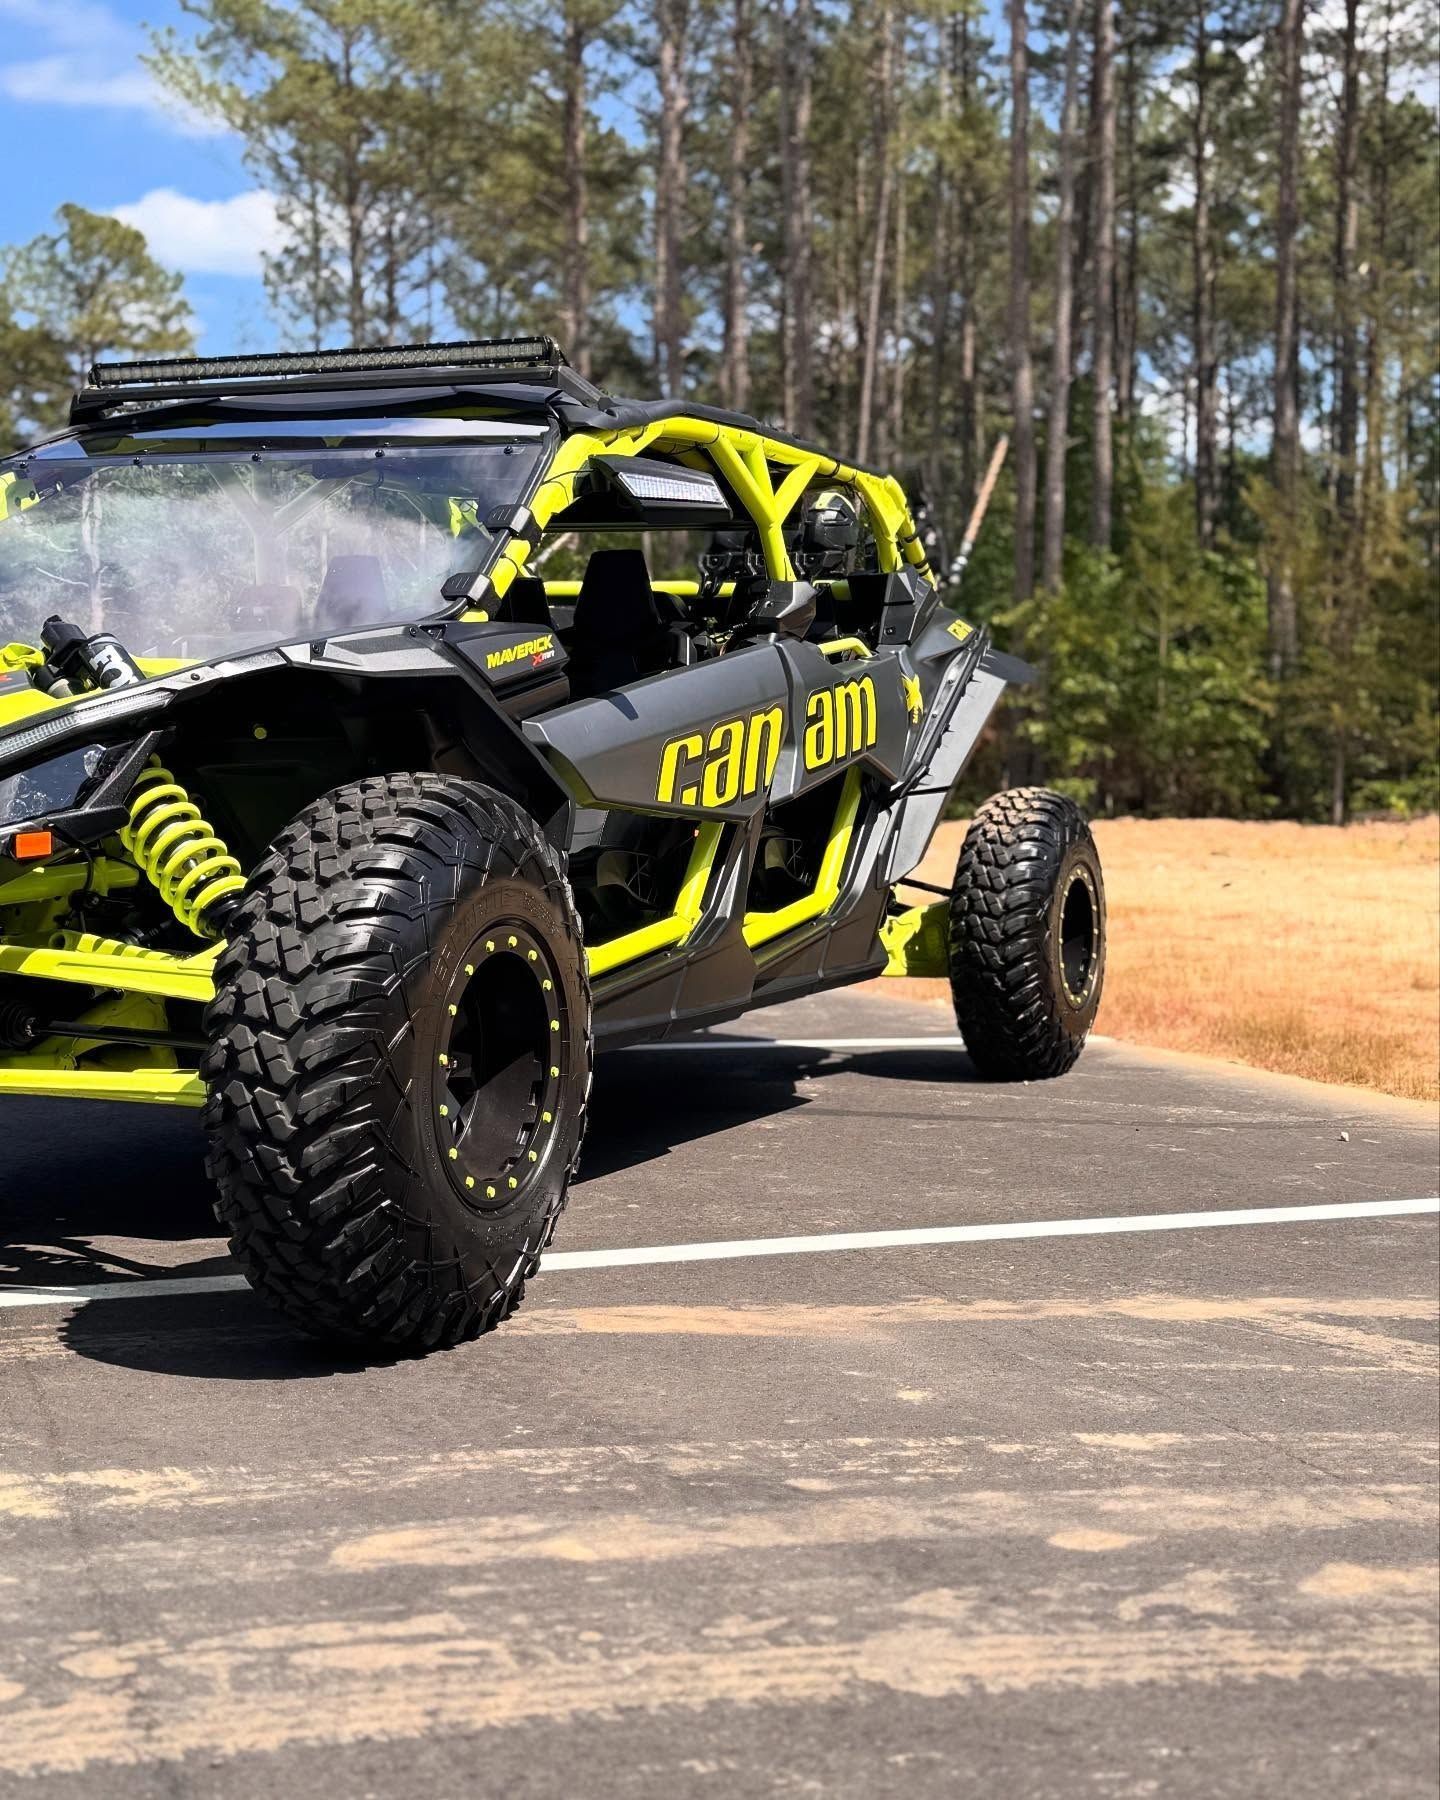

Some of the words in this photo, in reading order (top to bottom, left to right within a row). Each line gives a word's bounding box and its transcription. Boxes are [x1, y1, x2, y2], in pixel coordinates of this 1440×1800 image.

[89, 644, 140, 688] FO
[486, 634, 554, 670] MAVERICK
[656, 702, 784, 808] can
[803, 674, 878, 772] am
